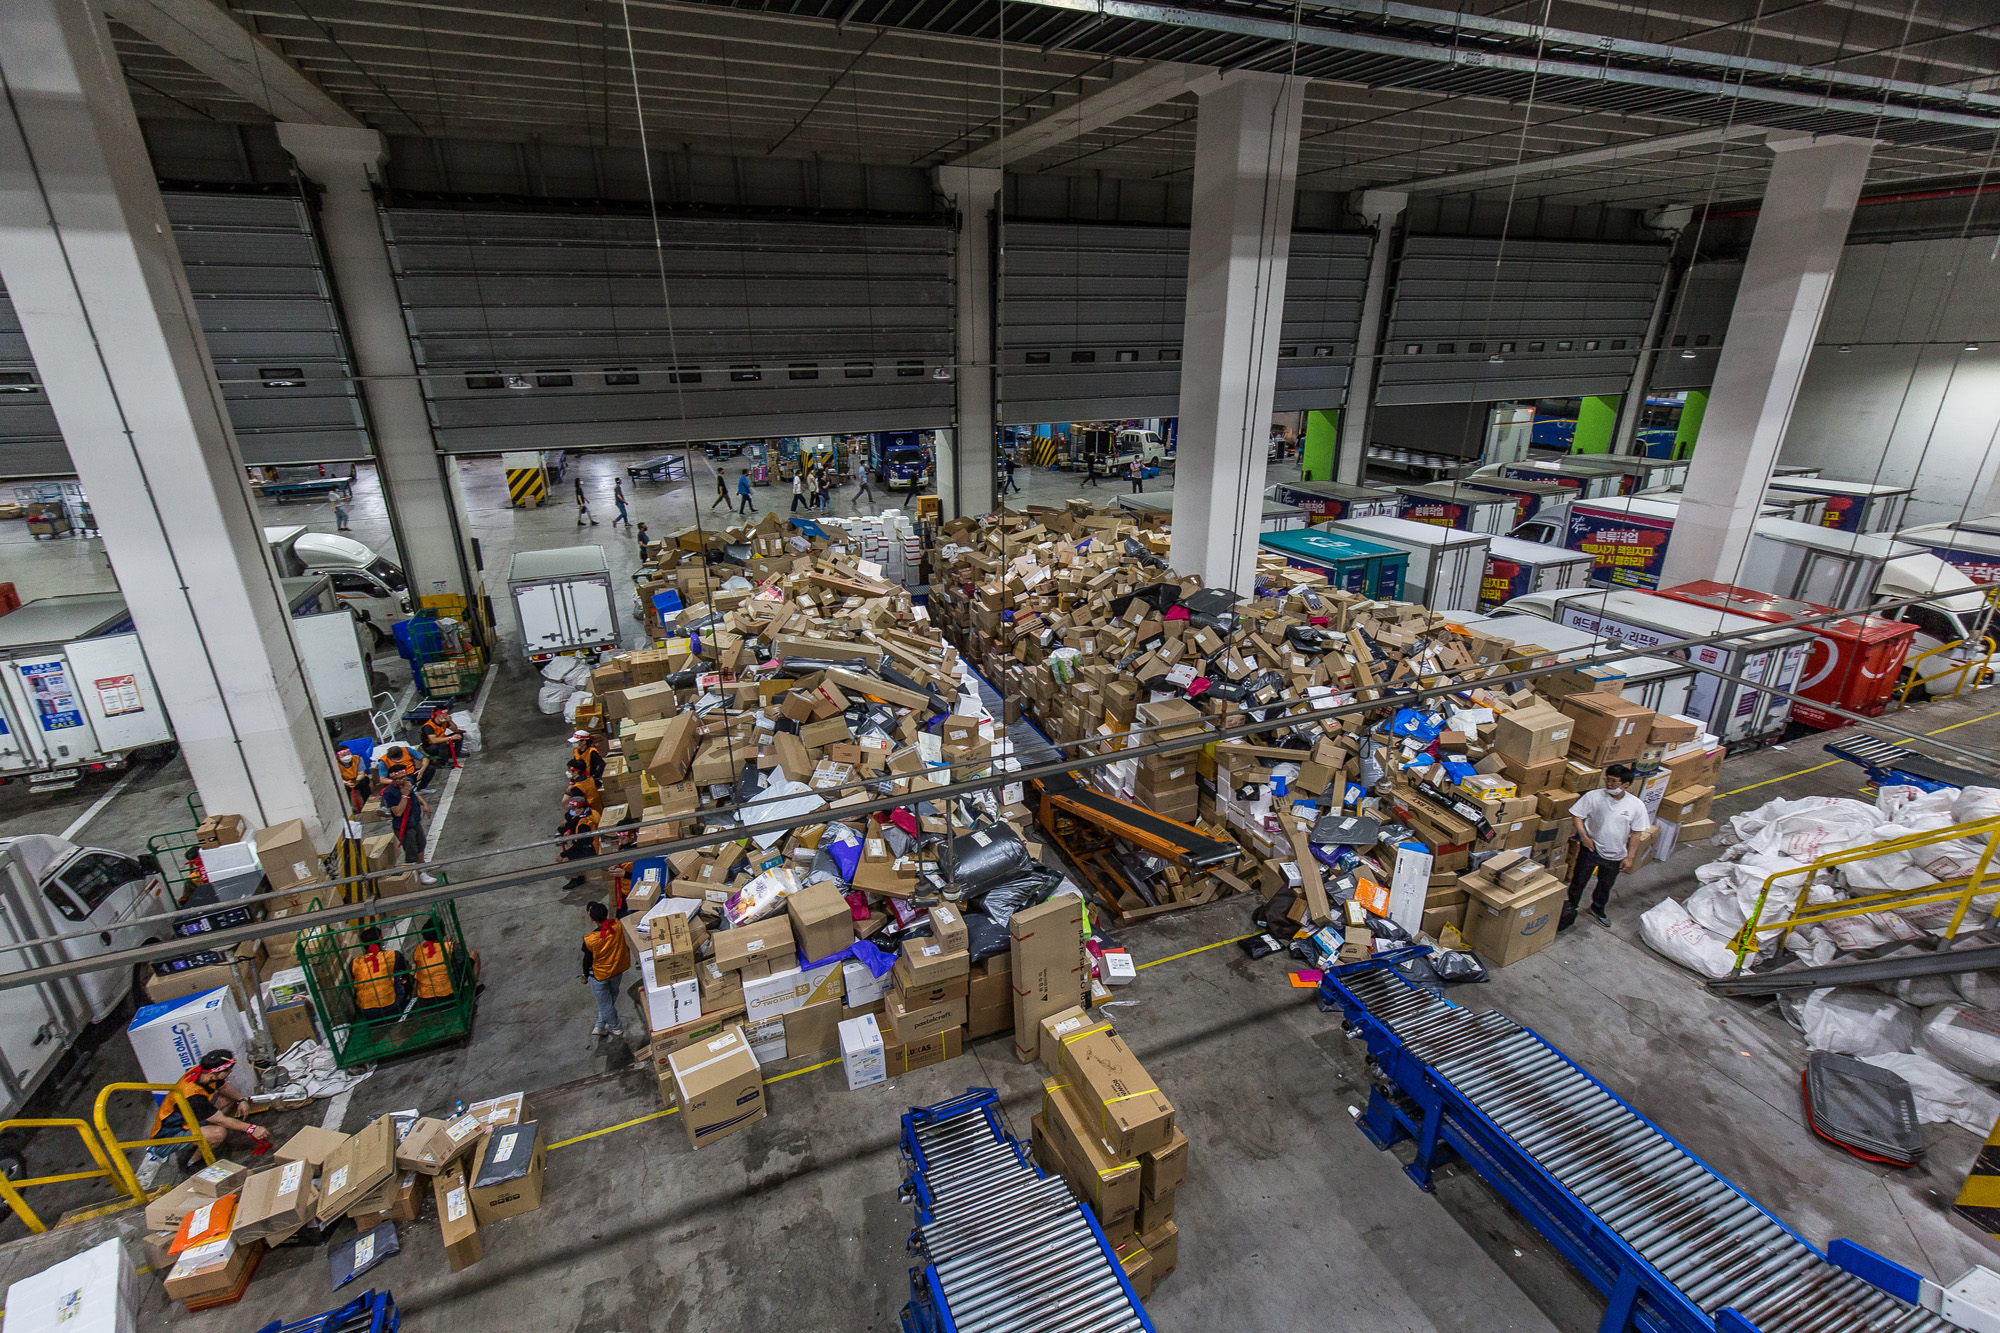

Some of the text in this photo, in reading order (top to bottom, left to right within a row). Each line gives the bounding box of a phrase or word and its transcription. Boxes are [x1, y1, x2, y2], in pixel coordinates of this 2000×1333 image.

[1596, 530, 1639, 543] 분류작업
[1617, 545, 1654, 557] 책임지고
[50, 721, 76, 730] SALE
[1525, 914, 1549, 932] ALZIP
[763, 994, 795, 1007] TWO SIDE
[173, 1036, 192, 1067] TWO SIDE
